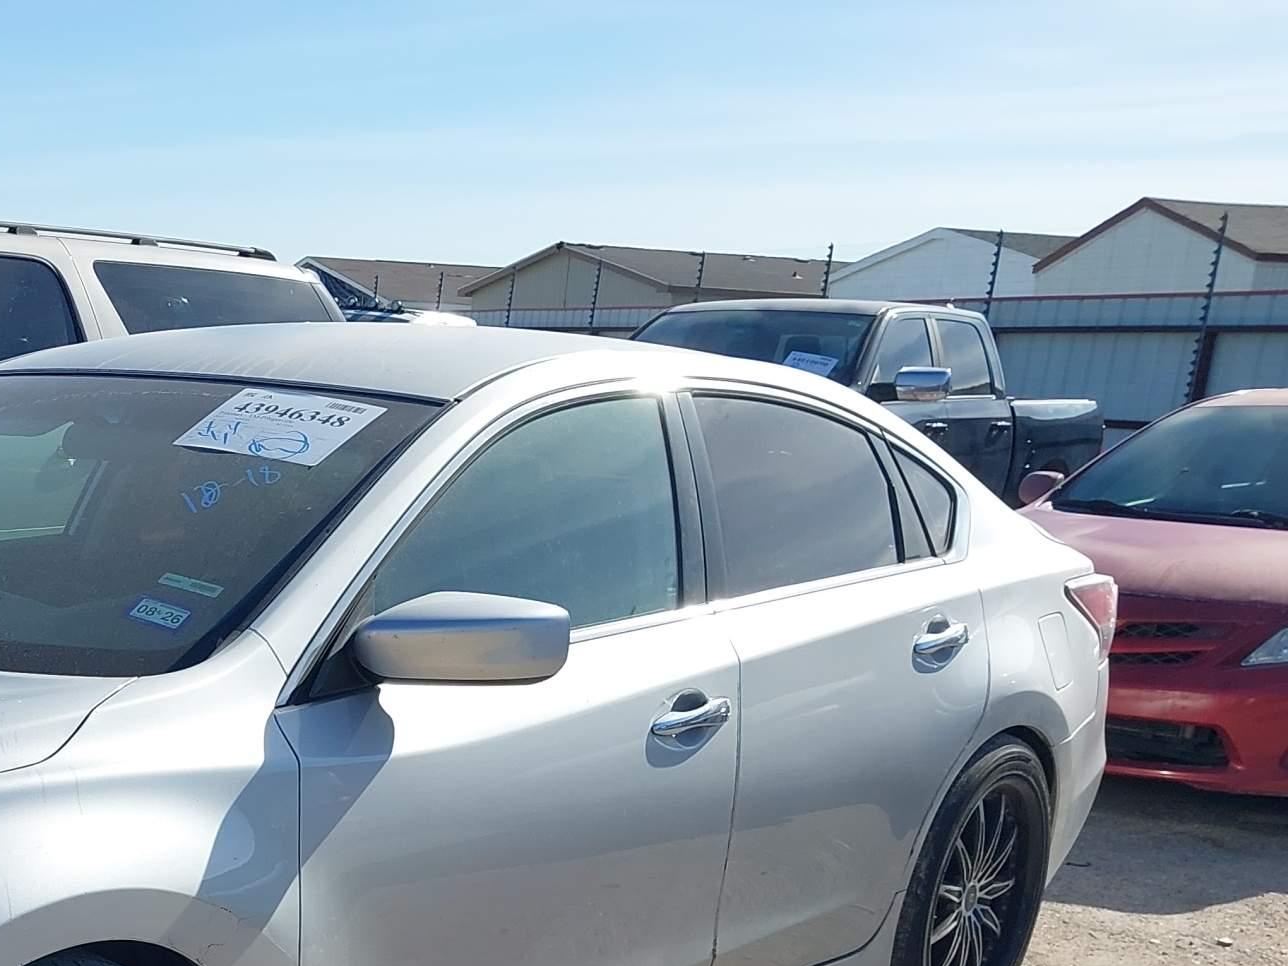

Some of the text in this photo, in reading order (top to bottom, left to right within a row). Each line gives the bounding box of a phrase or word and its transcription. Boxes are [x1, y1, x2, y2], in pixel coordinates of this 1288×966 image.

[234, 401, 351, 428] 43946348
[136, 604, 183, 625] 08 26
